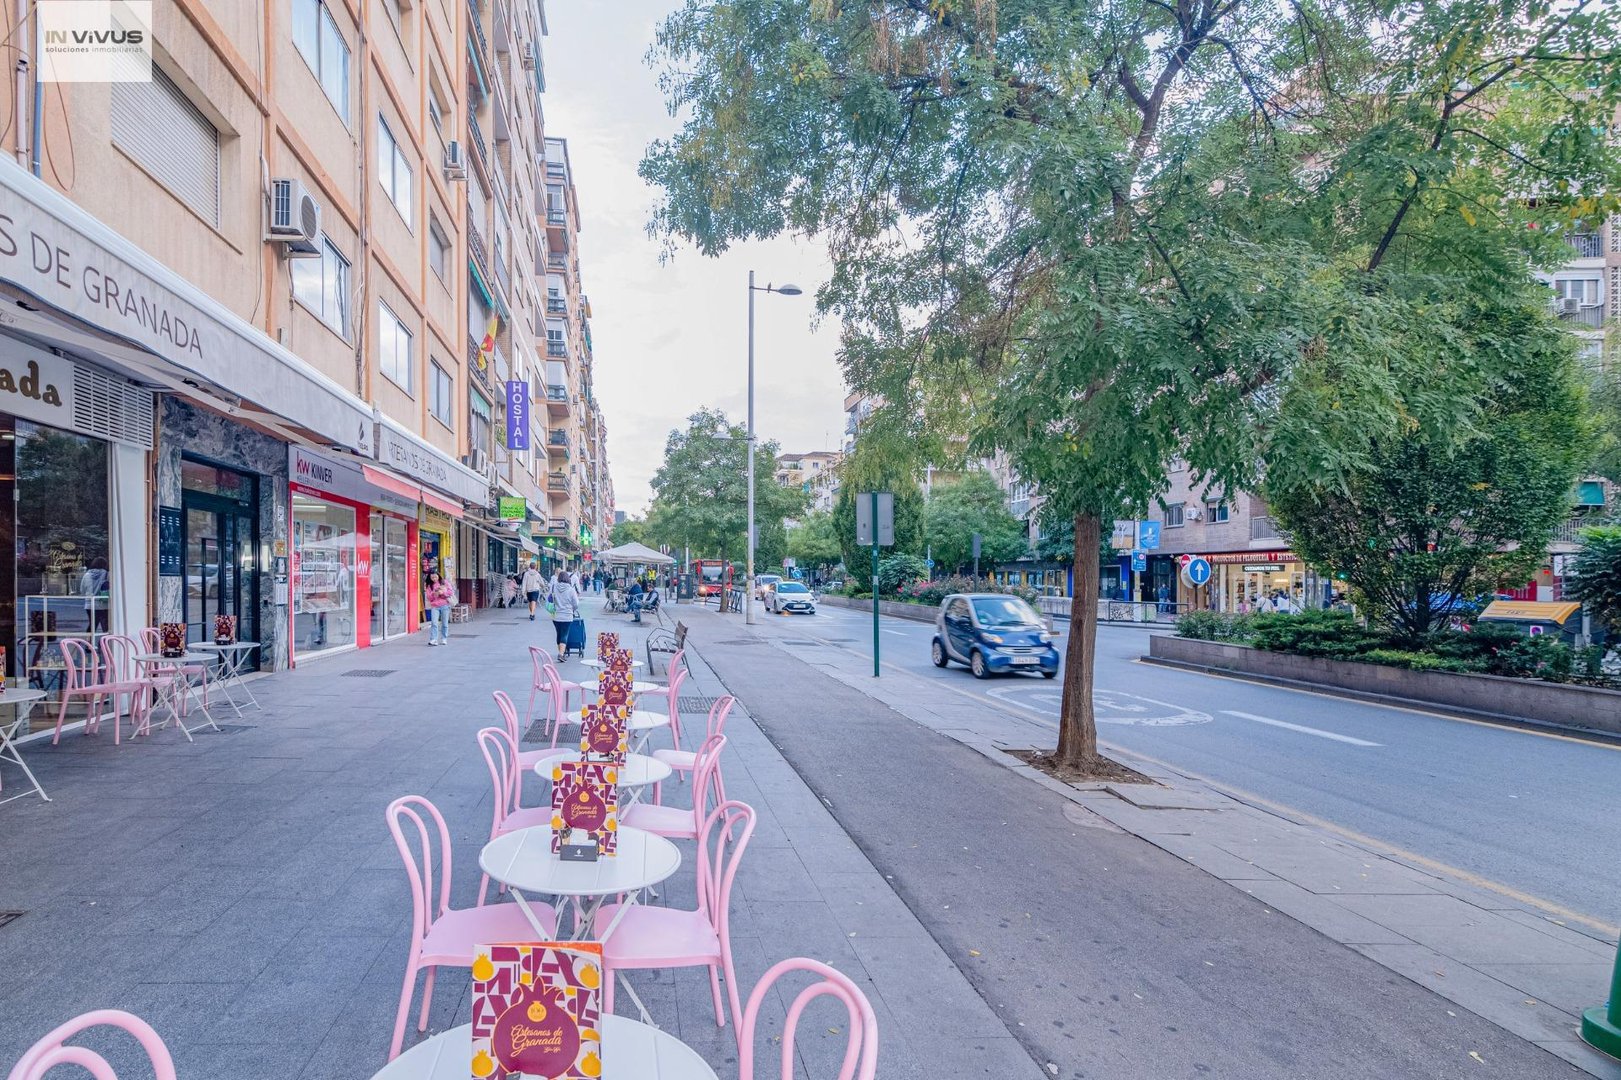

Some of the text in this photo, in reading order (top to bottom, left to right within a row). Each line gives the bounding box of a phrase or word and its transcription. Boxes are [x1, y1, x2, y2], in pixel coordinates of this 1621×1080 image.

[31, 231, 71, 289] DE
[83, 266, 203, 359] GRANADA
[512, 382, 523, 448] HOSTAL
[510, 1034, 562, 1057] Granada
[553, 1026, 563, 1037] de
